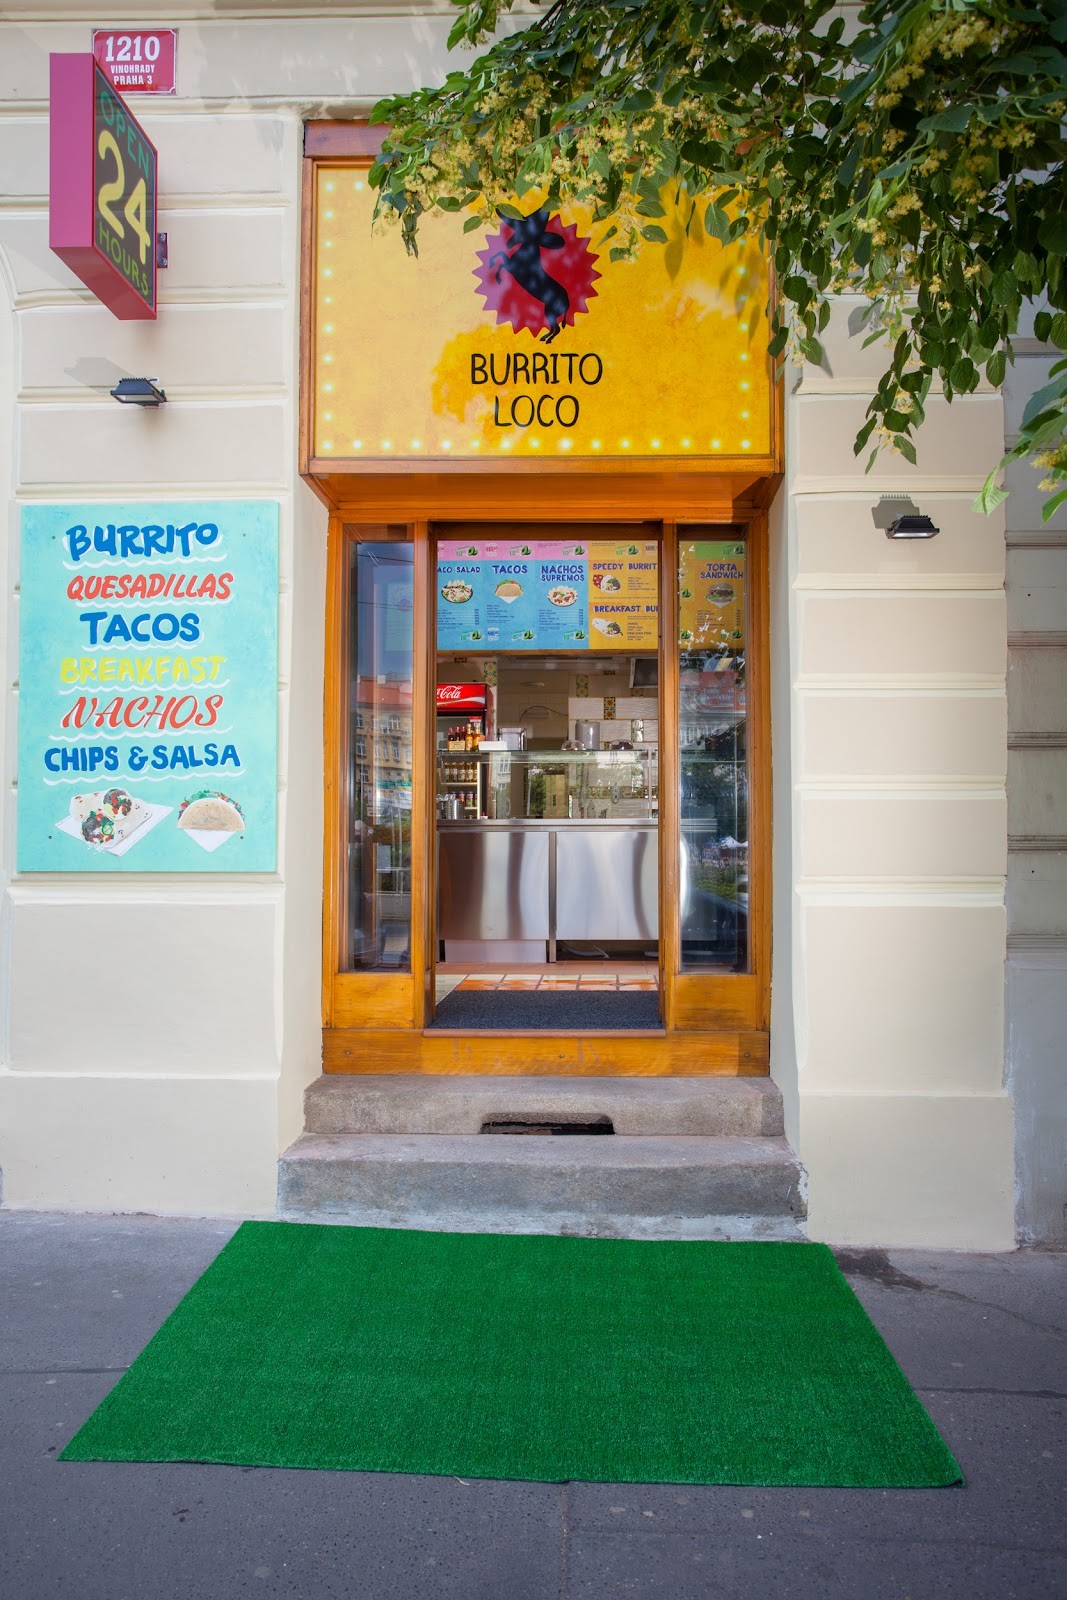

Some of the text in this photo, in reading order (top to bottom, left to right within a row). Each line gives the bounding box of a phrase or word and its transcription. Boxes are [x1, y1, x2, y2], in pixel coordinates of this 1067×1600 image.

[105, 35, 160, 62] 1210
[110, 64, 155, 74] VINOHRADY
[113, 75, 153, 85] PRAHA 3
[100, 91, 149, 179] OPEN
[98, 130, 150, 265] 24
[99, 223, 149, 296] HOURS
[471, 352, 603, 386] BURRITO
[494, 394, 580, 428] LOCO
[65, 522, 219, 561] BURRITO
[492, 565, 528, 574] TACOS
[541, 565, 584, 574] NACHOS
[700, 571, 743, 579] SANDWICH
[707, 563, 737, 571] TORTA
[67, 573, 234, 601] QUESADILLAS
[594, 605, 641, 613] BREAKFAST
[79, 612, 200, 645] TACOS
[60, 655, 227, 684] BREAKFAST
[62, 694, 224, 730] NACHOS
[44, 743, 241, 772] CHIPS & SALSA
